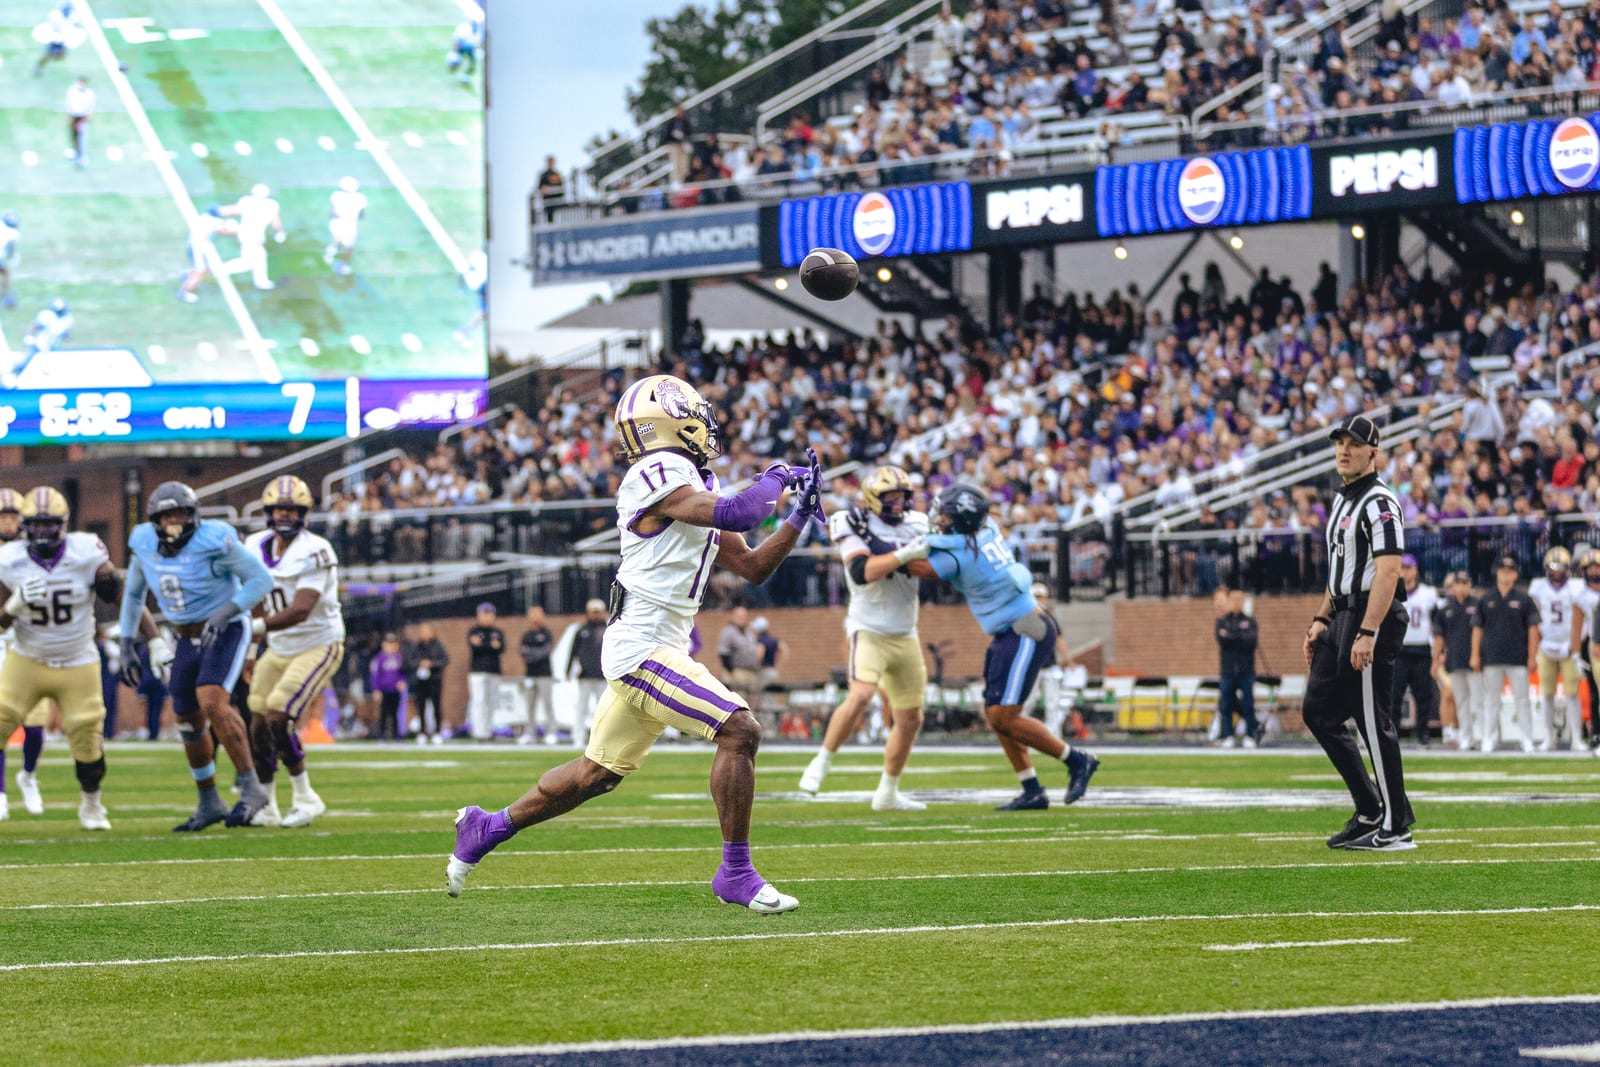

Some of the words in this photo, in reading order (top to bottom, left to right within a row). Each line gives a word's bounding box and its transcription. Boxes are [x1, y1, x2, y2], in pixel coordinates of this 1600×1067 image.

[1330, 148, 1438, 196] PEPSI
[987, 183, 1083, 230] PEPSI
[567, 234, 649, 265] UNDER
[653, 223, 759, 256] ARMOUR
[281, 383, 316, 434] 7
[640, 461, 667, 492] 17
[27, 589, 73, 626] 56
[160, 574, 185, 612] 9
[1551, 602, 1563, 624] 5
